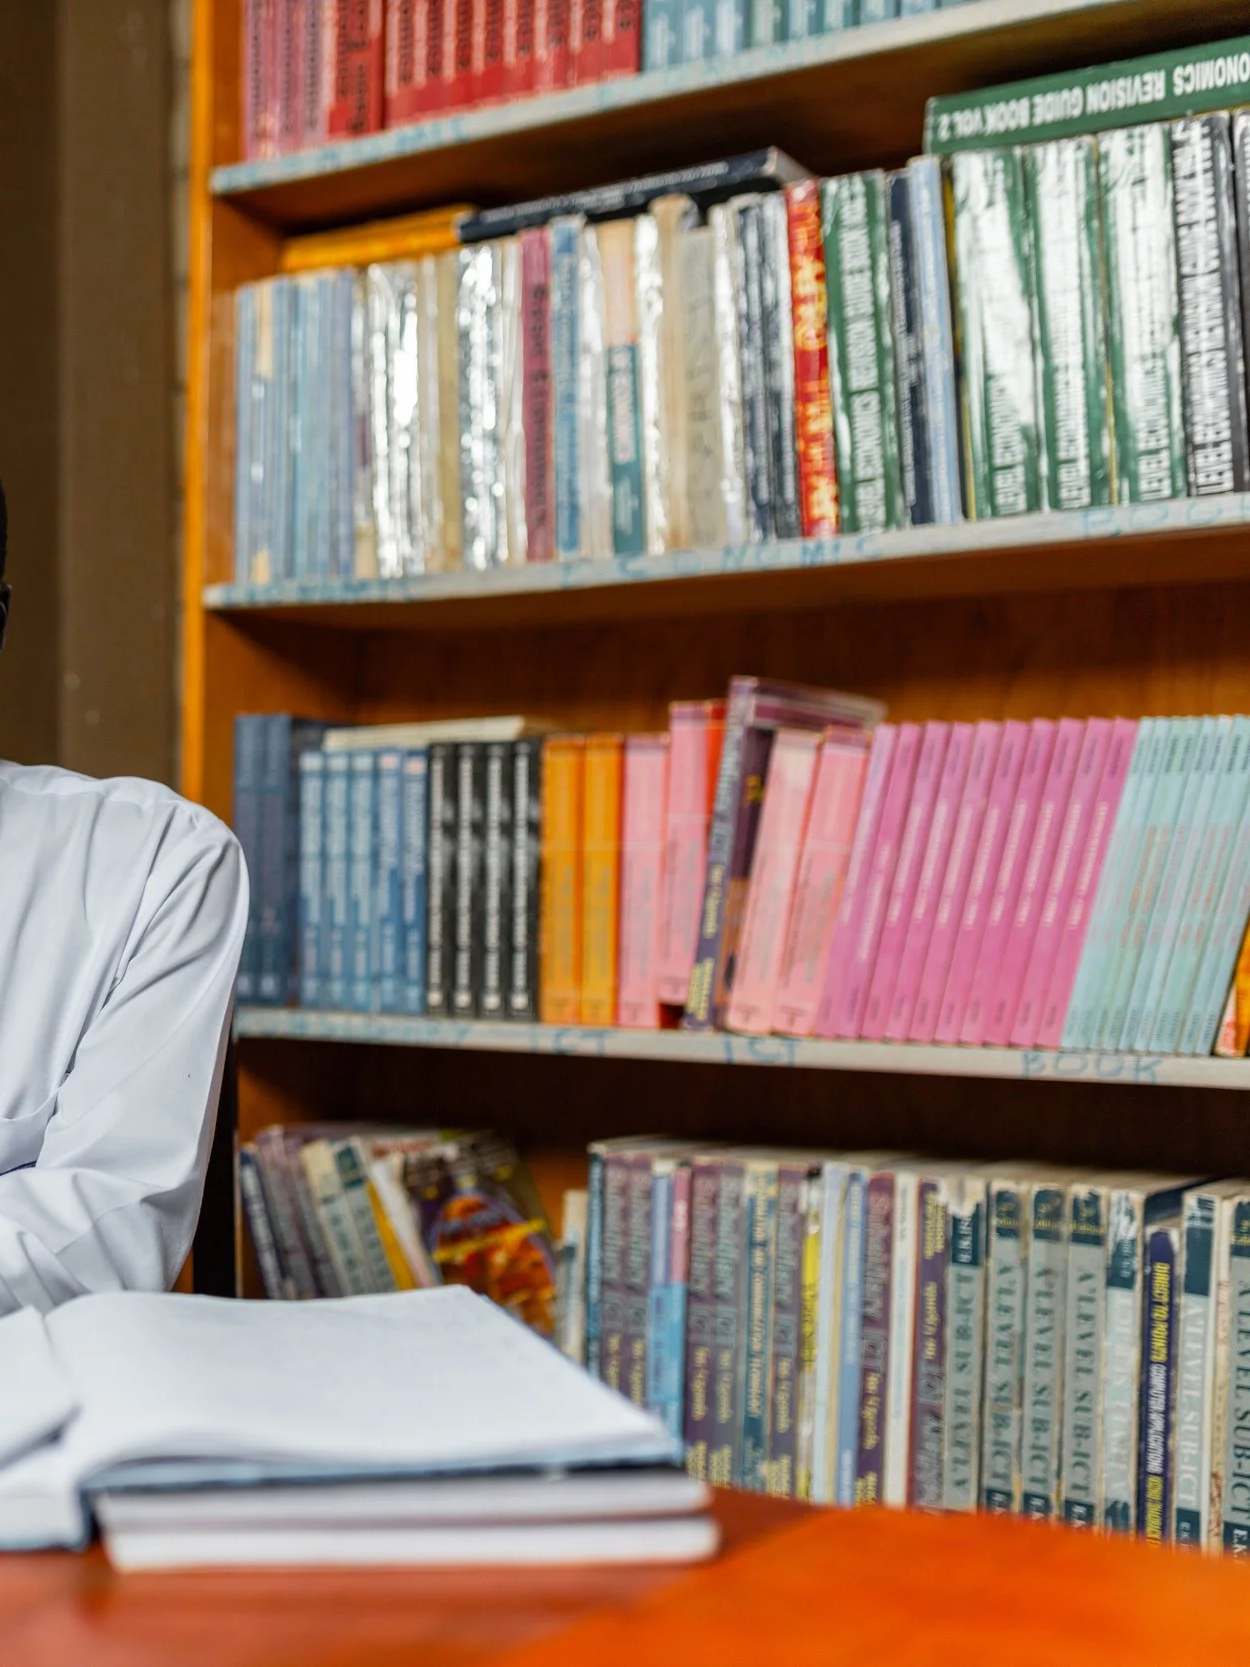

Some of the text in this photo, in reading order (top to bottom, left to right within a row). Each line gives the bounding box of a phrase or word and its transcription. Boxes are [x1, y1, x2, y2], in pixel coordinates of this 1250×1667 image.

[938, 53, 1250, 142] ONOMICS REVISION GUIDE BOOK VOL 2
[849, 391, 883, 480] ECONOMICS
[1058, 462, 1091, 509] LEVEL
[1137, 449, 1172, 499] LEVEL
[1194, 446, 1234, 494] LEVEL
[723, 1034, 802, 1067] ICT
[1020, 1050, 1162, 1086] BOOK
[1151, 1262, 1170, 1302] DIRECT
[1151, 1304, 1168, 1320] TO
[954, 1272, 974, 1375] SUB-ICT
[1073, 1268, 1098, 1376] A'LEVEL
[1149, 1321, 1168, 1362] POINTS
[1148, 1363, 1166, 1411] COMPUTER
[989, 1383, 1014, 1482] SUB-ICT
[1030, 1383, 1052, 1488] SUB-ICT
[1071, 1390, 1093, 1495] SUB-ICT
[1146, 1412, 1165, 1473] APPLICATIONS
[1177, 1409, 1202, 1506] SUB-ICT
[1228, 1407, 1250, 1520] SUB-ICT
